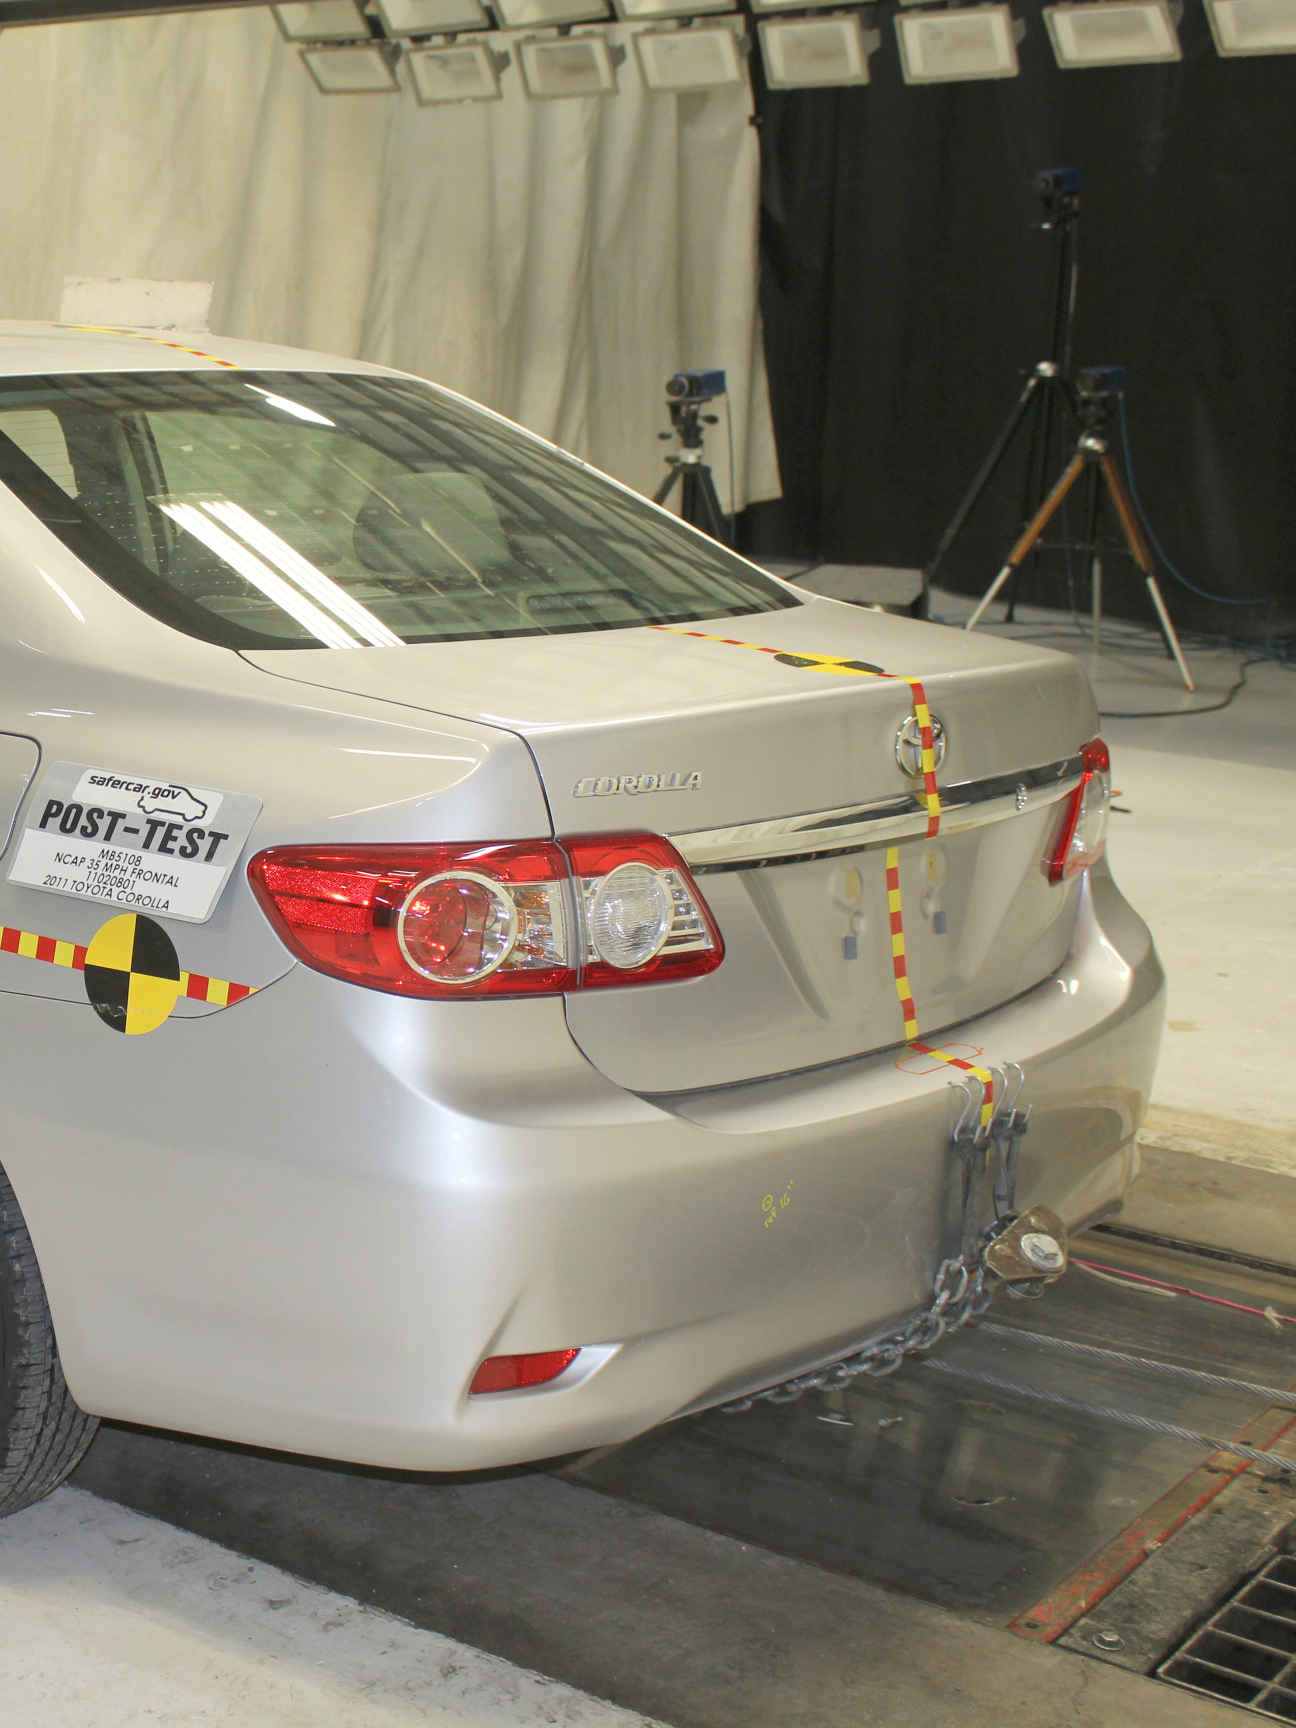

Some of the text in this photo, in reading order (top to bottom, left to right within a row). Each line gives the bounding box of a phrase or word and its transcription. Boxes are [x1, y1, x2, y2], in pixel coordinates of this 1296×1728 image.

[88, 774, 182, 800] safercar.gov
[573, 771, 702, 798] COROLLA
[38, 798, 230, 862] POST-TEST
[54, 852, 180, 888] NCAP 35 MPH FRONTAL
[98, 848, 143, 867] MB5108
[42, 874, 170, 911] 2011 TOYOTA COROLLA
[85, 870, 137, 890] 11020801
